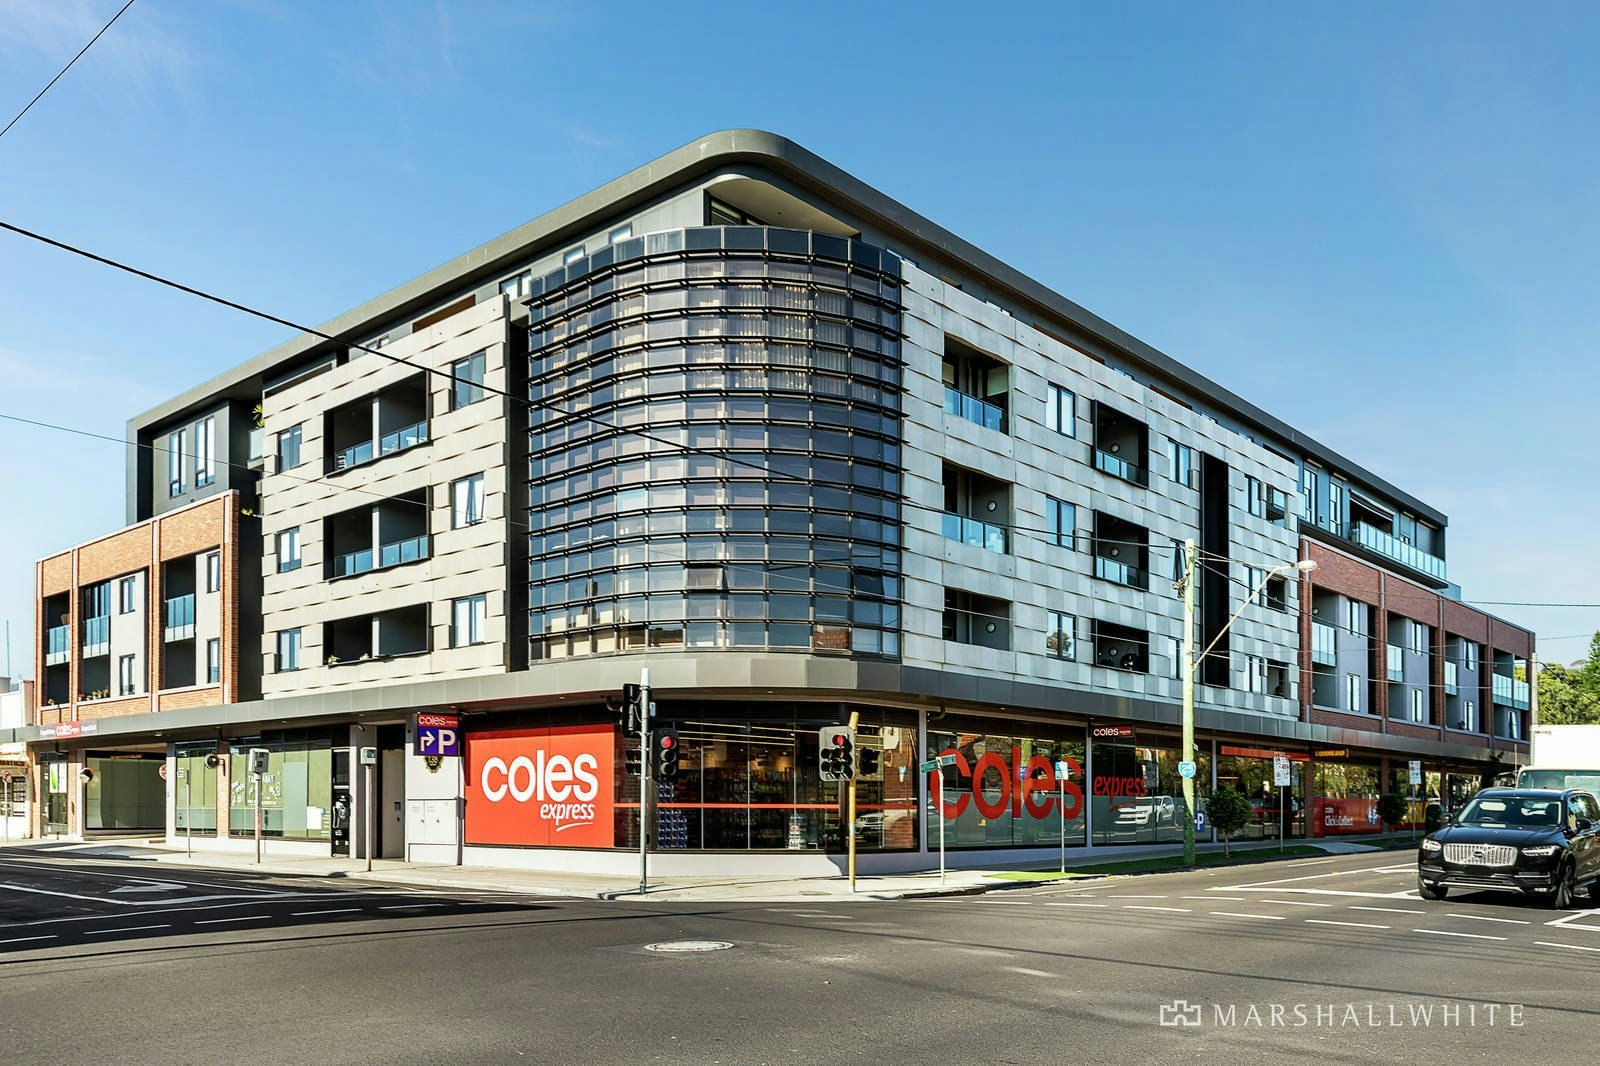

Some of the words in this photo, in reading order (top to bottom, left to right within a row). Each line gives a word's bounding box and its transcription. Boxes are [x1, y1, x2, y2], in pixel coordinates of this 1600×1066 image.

[418, 716, 446, 726] coles
[1093, 727, 1119, 737] coles
[438, 729, 456, 754] P
[481, 749, 599, 802] coles
[929, 745, 1083, 820] coles
[1093, 776, 1147, 804] express
[539, 803, 595, 826] express
[1197, 812, 1204, 830] P
